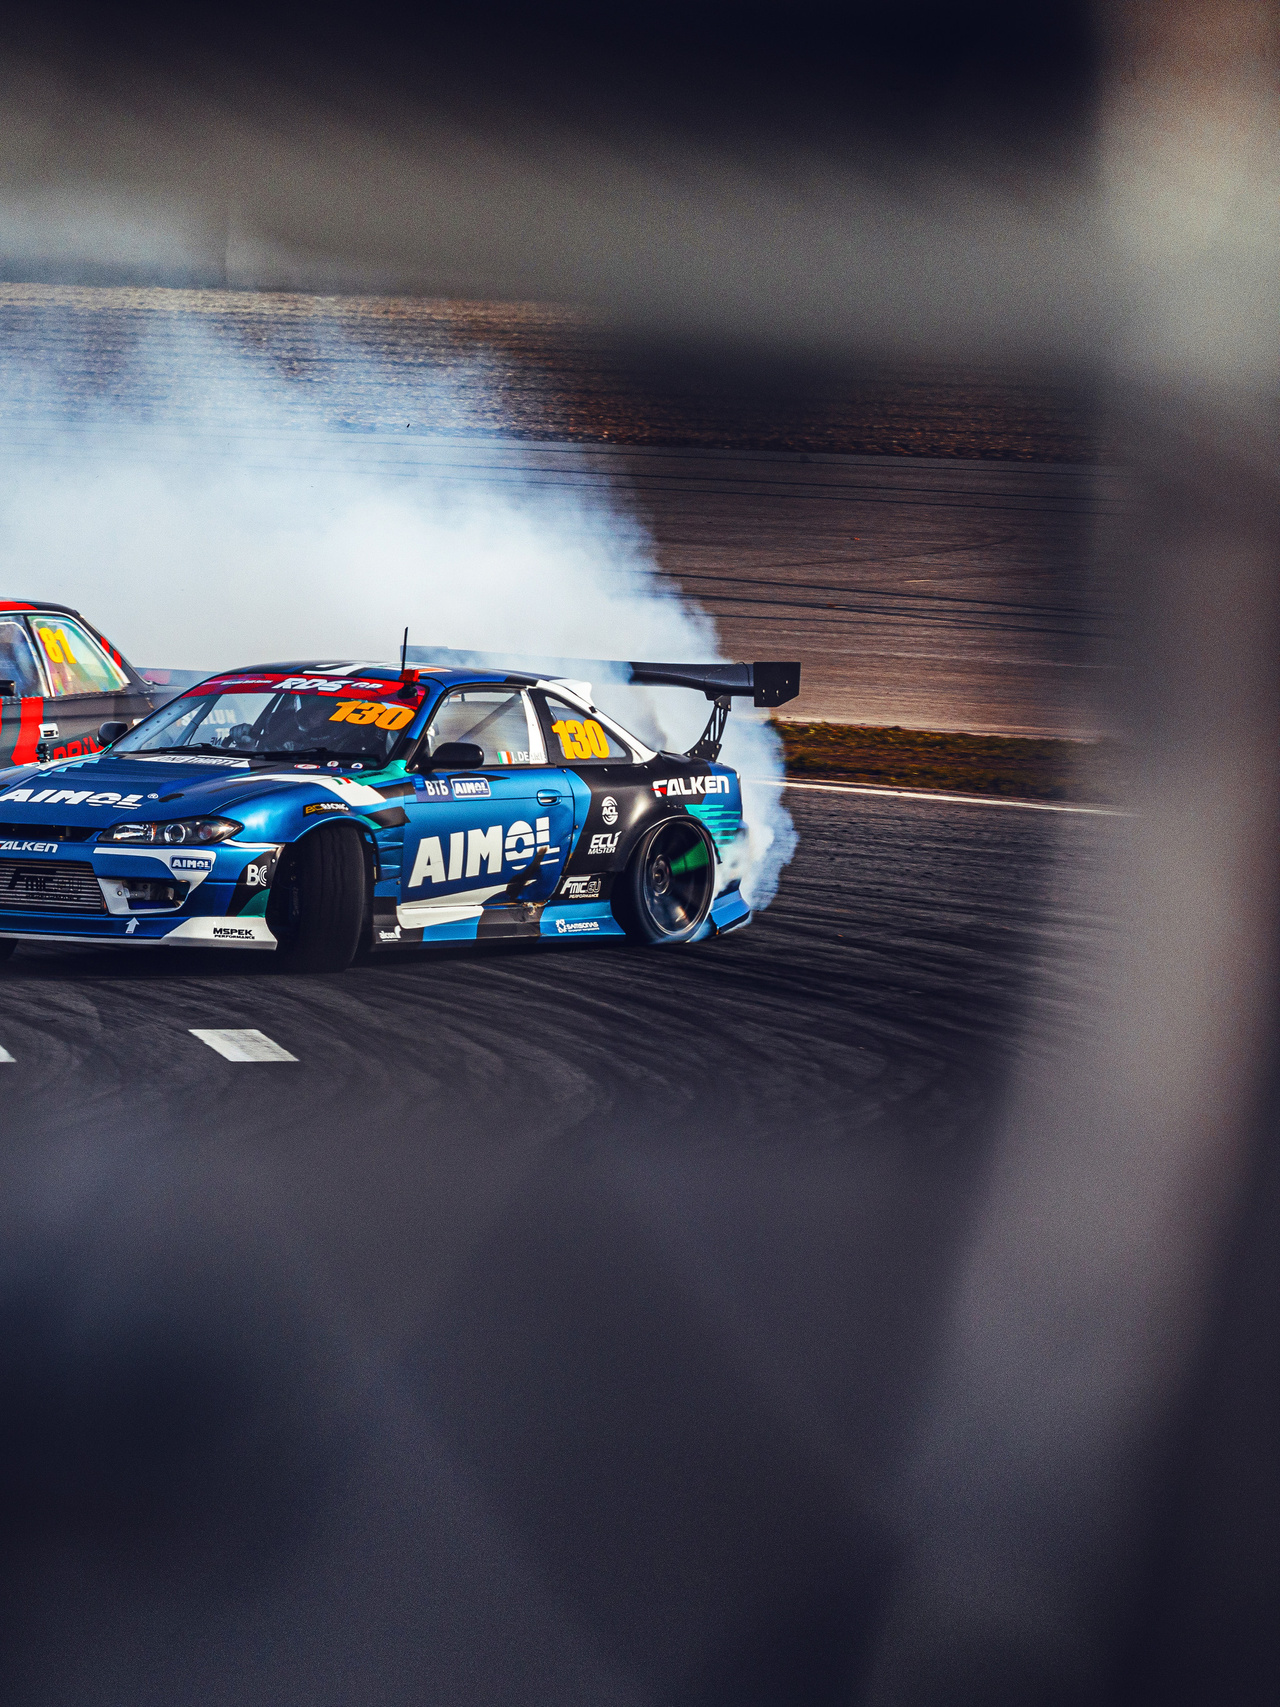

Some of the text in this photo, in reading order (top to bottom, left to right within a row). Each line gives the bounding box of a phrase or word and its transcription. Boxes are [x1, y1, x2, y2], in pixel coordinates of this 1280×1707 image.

[38, 627, 77, 664] 81
[271, 677, 355, 692] RDS
[329, 700, 416, 731] 130
[551, 719, 610, 760] 130
[424, 779, 449, 796] ВТБ
[455, 781, 488, 794] AIMOL
[651, 775, 730, 798] FALKEN
[602, 806, 619, 816] ACL
[591, 831, 622, 849] ECU
[407, 816, 561, 888] AIMOL
[588, 847, 616, 855] MASTER
[171, 859, 211, 869] AIMOL
[213, 927, 253, 936] MSPEK
